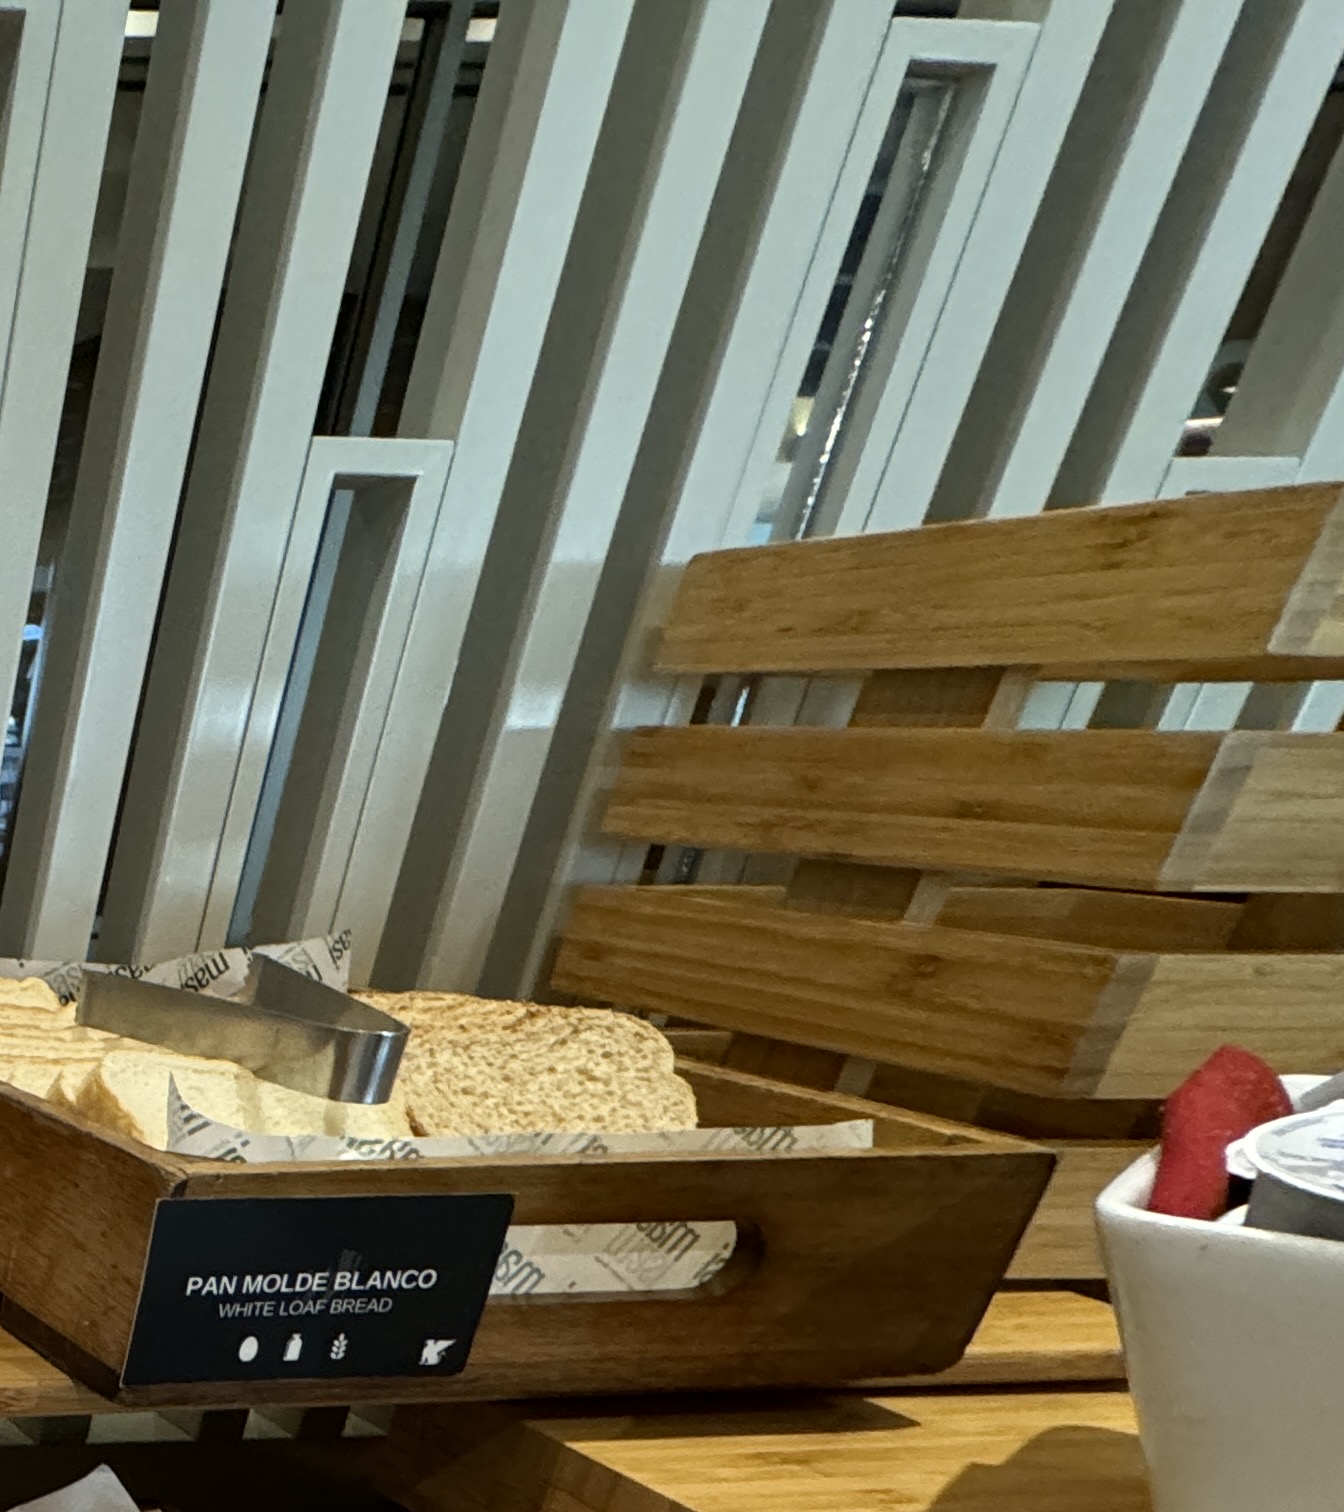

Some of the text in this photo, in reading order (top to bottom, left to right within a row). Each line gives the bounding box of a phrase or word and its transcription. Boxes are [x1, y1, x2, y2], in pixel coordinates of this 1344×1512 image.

[185, 1268, 438, 1297] PAN MOLDE BLANCO
[218, 1297, 393, 1319] WHITE LOAF BREAD
